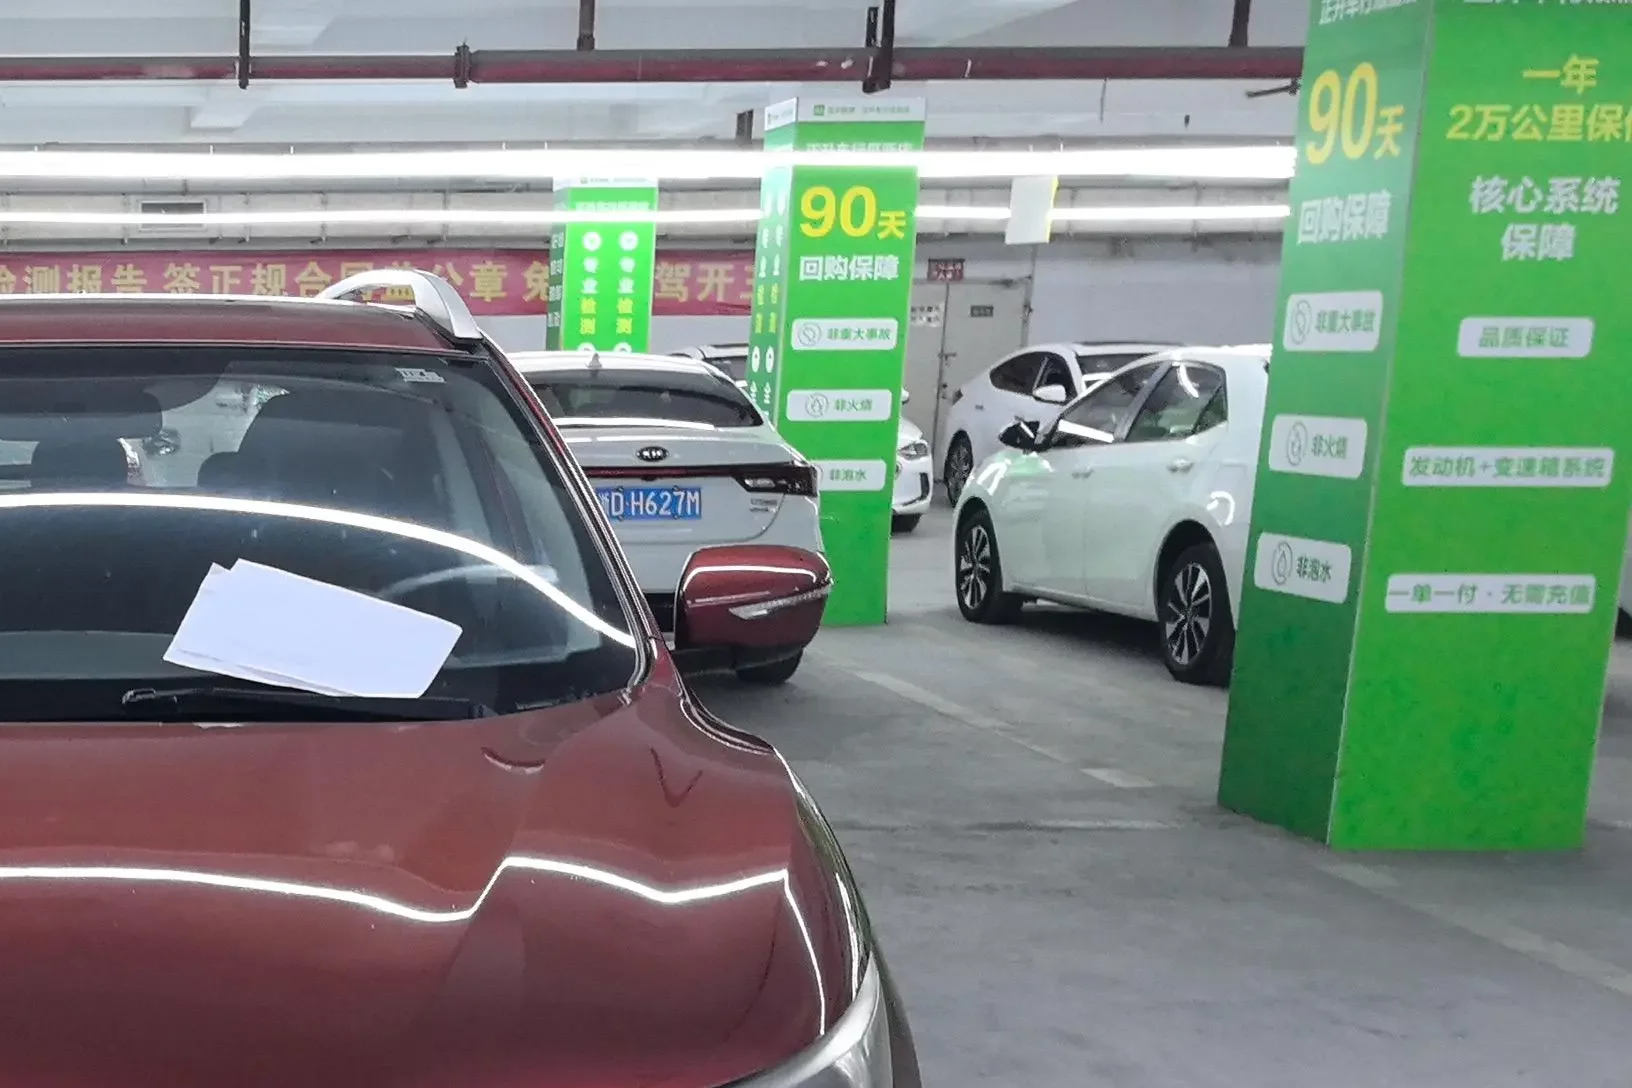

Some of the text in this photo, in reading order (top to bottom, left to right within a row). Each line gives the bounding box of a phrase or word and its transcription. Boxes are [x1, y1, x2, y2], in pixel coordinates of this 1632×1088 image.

[1522, 55, 1600, 94] 一年
[1305, 61, 1406, 165] 90天
[800, 186, 907, 240] 90天
[1469, 175, 1621, 215] 核心系统
[1297, 189, 1392, 245] 回购保障
[1500, 223, 1577, 262] 保障
[799, 256, 900, 281] 回购保障
[1477, 326, 1571, 349] 品质保证
[1408, 454, 1606, 480] 发动机+变速箱系统
